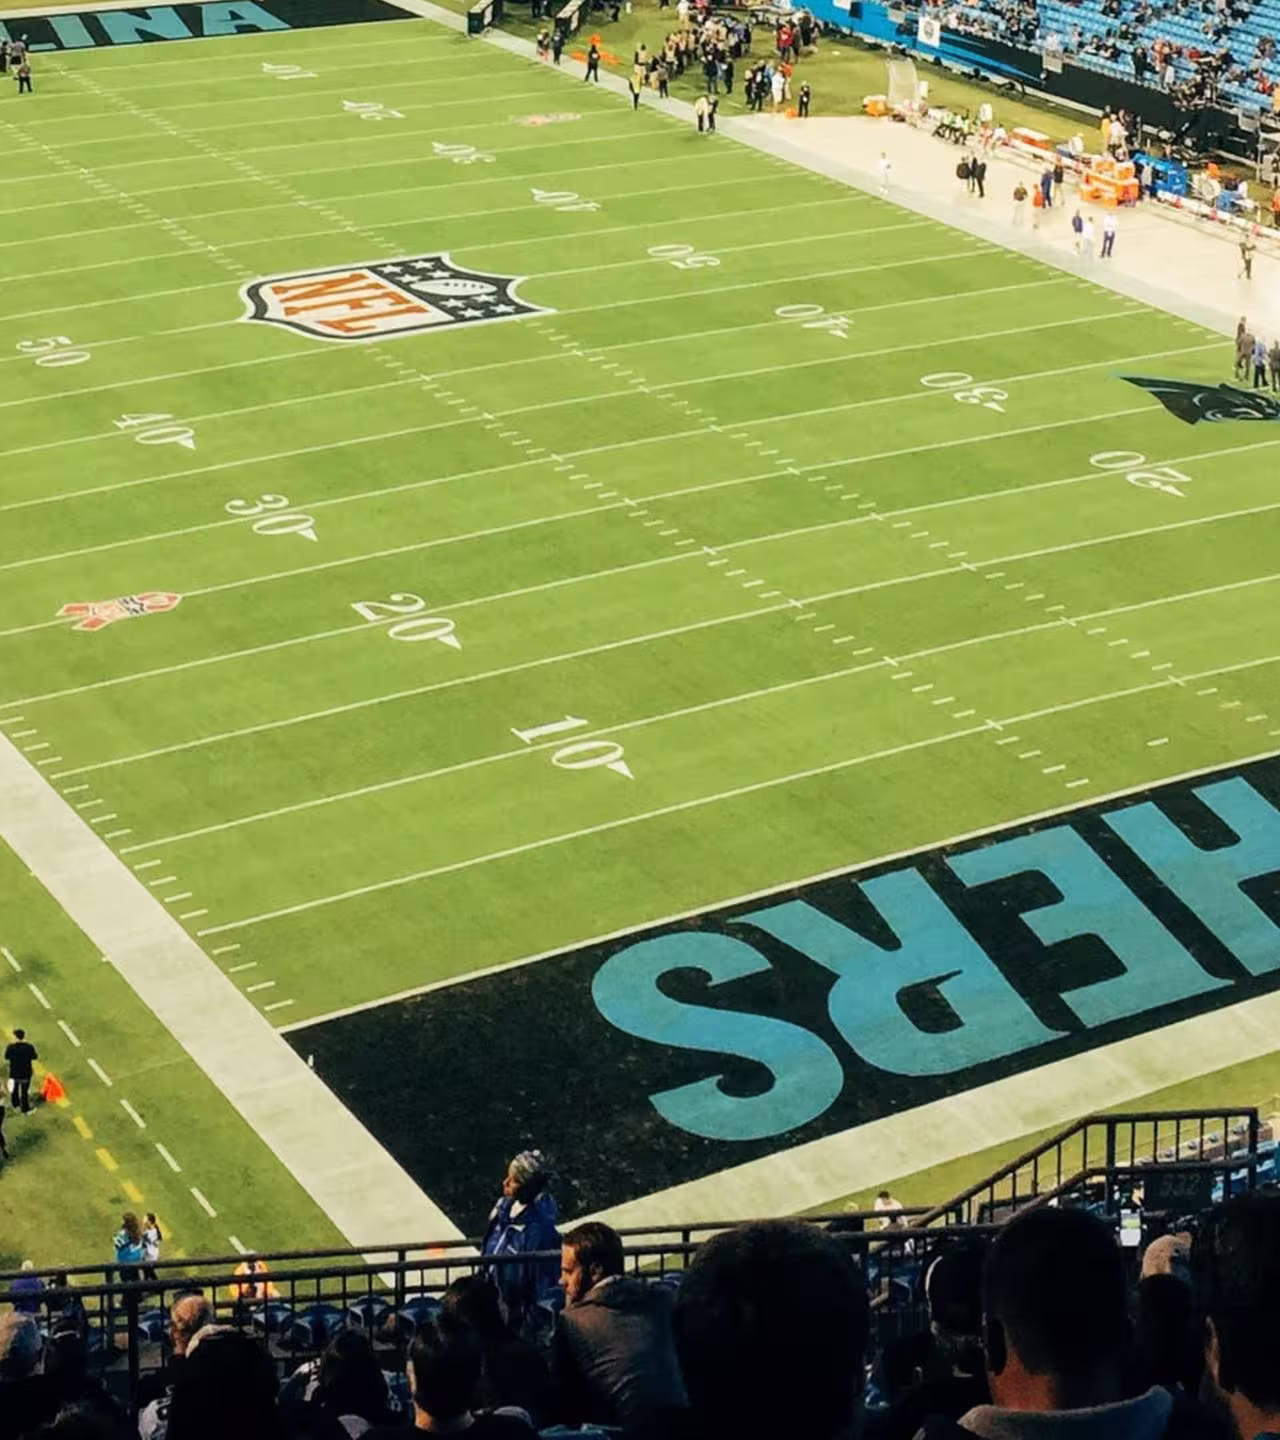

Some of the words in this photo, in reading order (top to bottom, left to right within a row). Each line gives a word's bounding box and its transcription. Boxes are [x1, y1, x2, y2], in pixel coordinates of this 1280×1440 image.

[646, 244, 720, 271] 50
[271, 272, 430, 334] NFL
[774, 302, 853, 333] 40
[16, 335, 91, 368] 50
[920, 371, 1009, 409] 30
[112, 411, 195, 446] 40
[1089, 450, 1192, 492] 20
[223, 494, 315, 536] 30
[350, 592, 457, 642] 20
[510, 715, 624, 769] 10
